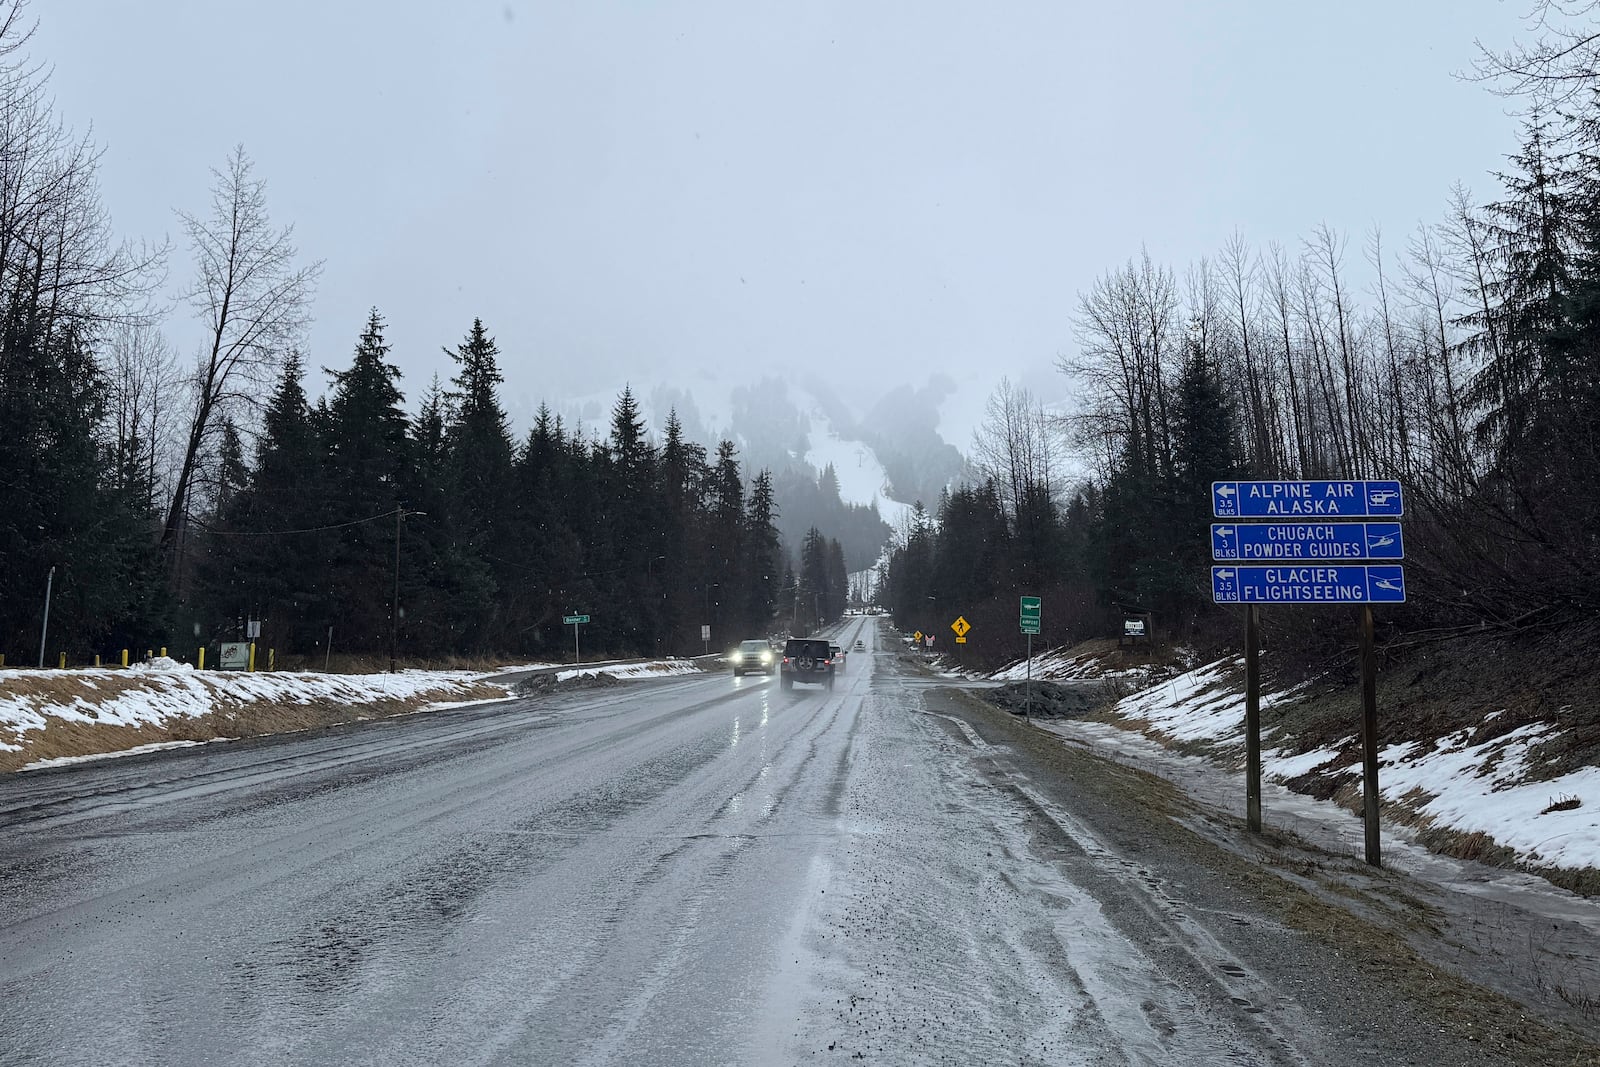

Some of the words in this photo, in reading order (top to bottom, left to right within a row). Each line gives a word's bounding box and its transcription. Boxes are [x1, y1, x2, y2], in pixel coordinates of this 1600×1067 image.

[1249, 484, 1312, 498] ALPINE
[1325, 484, 1354, 497] AIR
[1219, 499, 1233, 508] 3.5
[1267, 499, 1339, 514] ALASKA
[1268, 526, 1335, 540] CHUGACH
[1222, 539, 1229, 548] 3
[1244, 543, 1302, 557] POWDER
[1309, 543, 1361, 557] GUIDES
[1215, 548, 1236, 558] BLKS
[1265, 569, 1339, 583] GLACIER
[1219, 582, 1232, 591] 3.5
[1244, 585, 1363, 600] FLIGHTSEEING
[1215, 592, 1237, 601] BLKS
